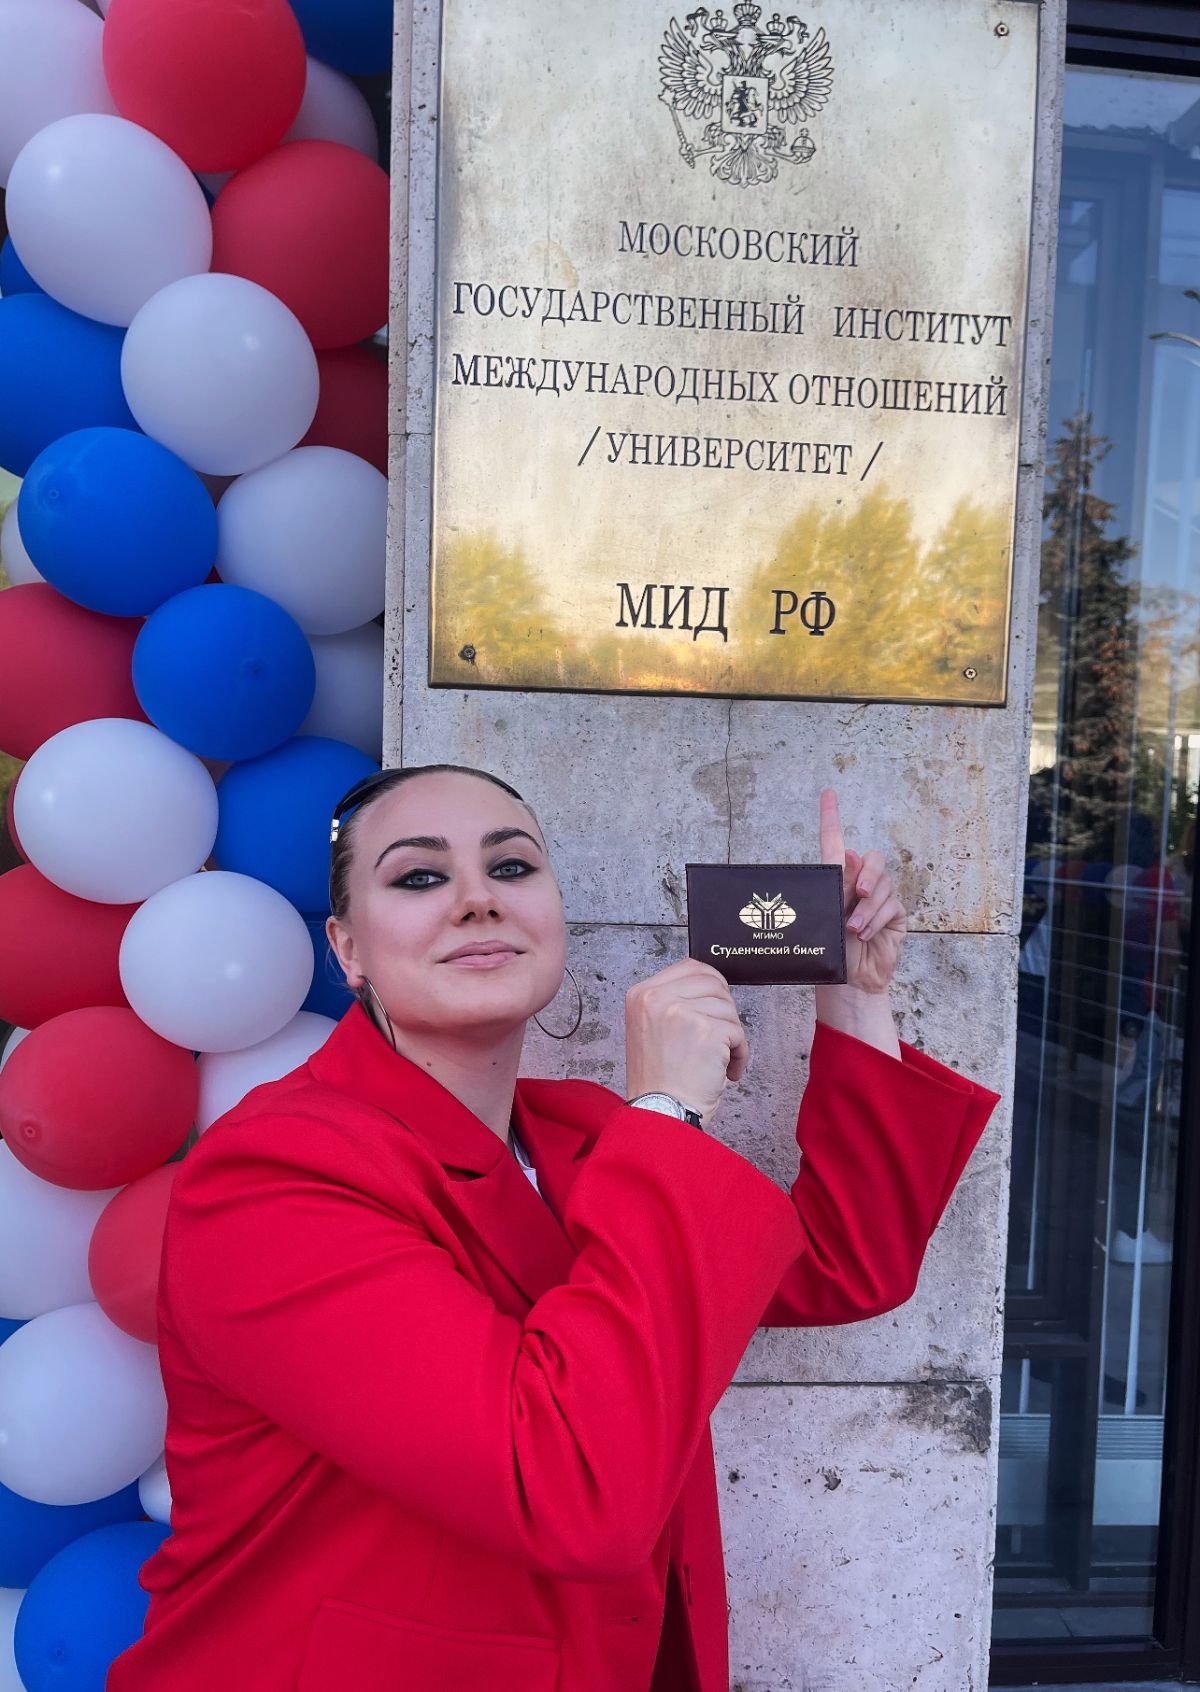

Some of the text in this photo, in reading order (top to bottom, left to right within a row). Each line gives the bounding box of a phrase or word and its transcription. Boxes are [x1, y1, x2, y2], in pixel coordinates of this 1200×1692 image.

[618, 220, 860, 267] МОСКОВСКИЙ
[452, 281, 1012, 347] ГОСУДАРСТВЕННЫЙ ИНСТИТУТ
[451, 353, 1008, 416] МЕЖДУНАРОДНЫХ ОТНОШЕНИЙ
[616, 583, 836, 642] МИД РФ
[710, 944, 825, 958] Студенческий билет
[752, 932, 784, 940] МГИМО
